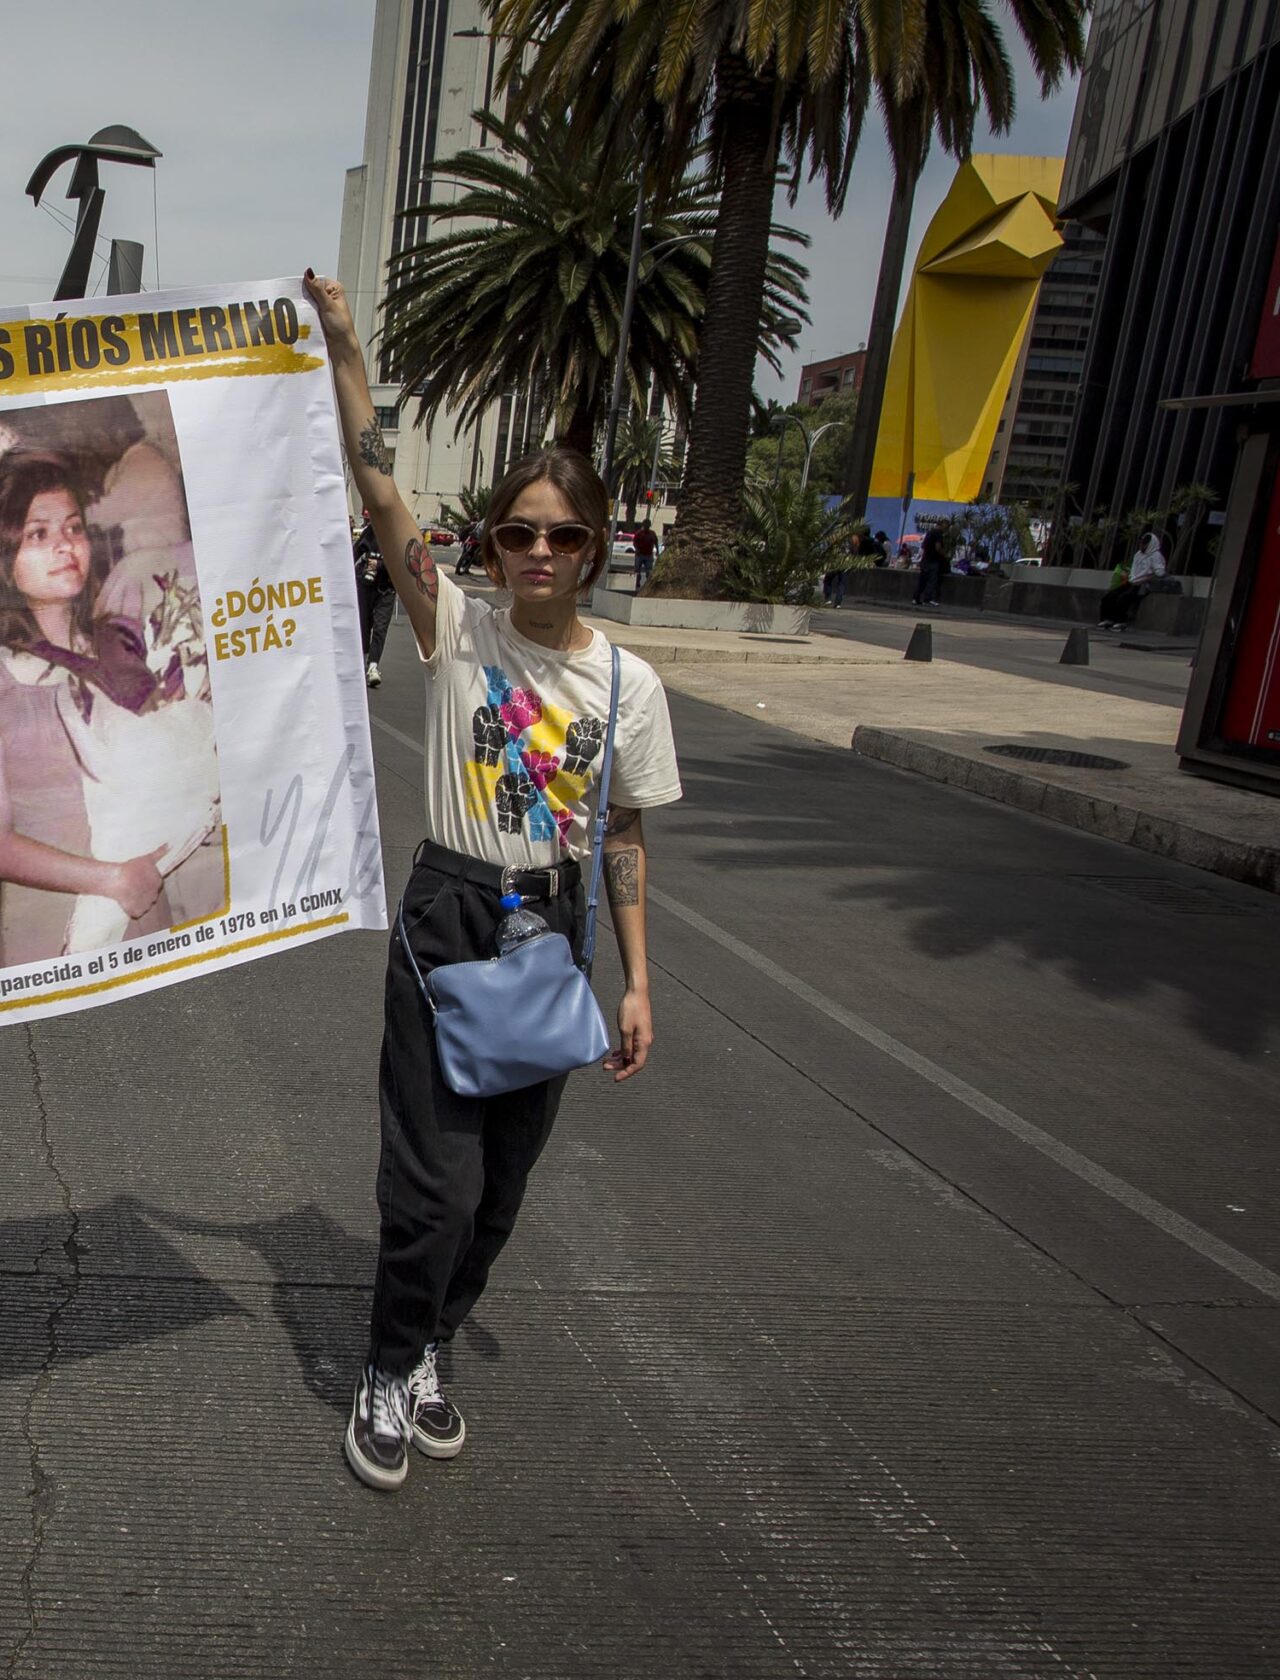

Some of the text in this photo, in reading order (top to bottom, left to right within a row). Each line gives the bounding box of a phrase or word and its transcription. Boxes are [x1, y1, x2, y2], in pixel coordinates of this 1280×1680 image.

[23, 312, 131, 376] RÍOS
[137, 296, 299, 361] MERINO
[211, 576, 324, 627] ¿DÓNDE
[214, 614, 297, 661] ESTÁ?
[87, 956, 105, 974] el
[108, 951, 119, 969] 5
[123, 947, 143, 964] de
[147, 933, 191, 957] enero
[195, 926, 215, 943] de
[219, 911, 257, 937] 1978
[260, 909, 279, 924] en
[282, 902, 297, 919] la
[300, 888, 343, 913] CDMX
